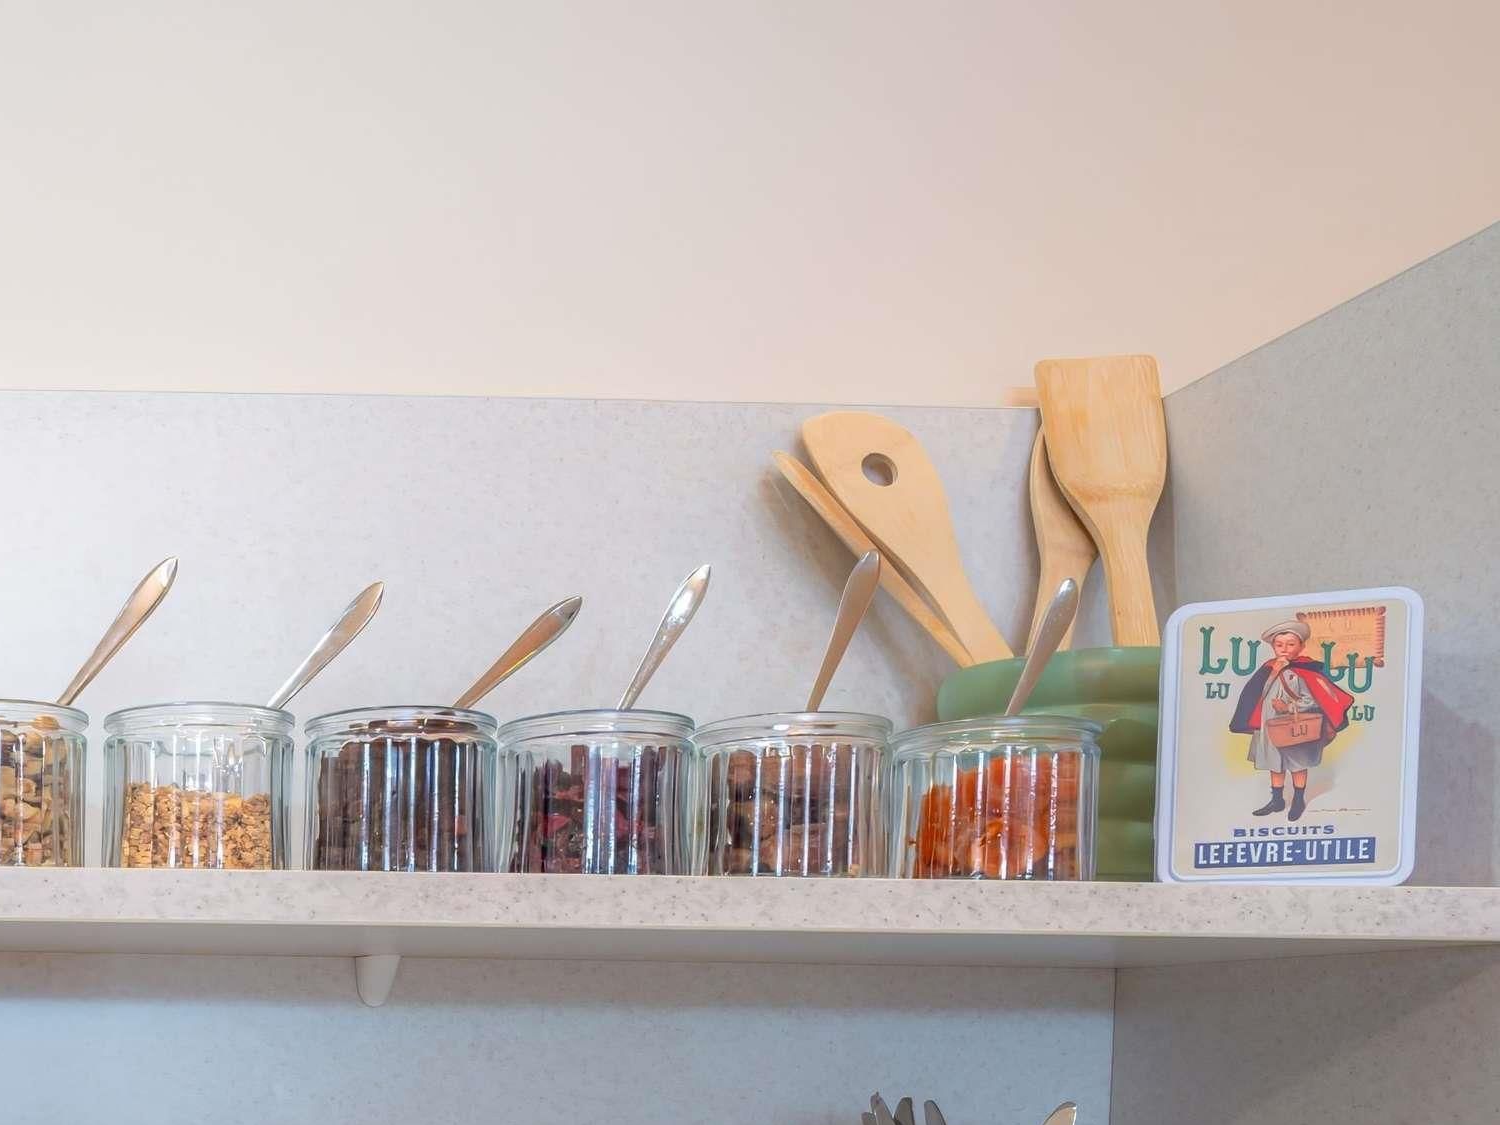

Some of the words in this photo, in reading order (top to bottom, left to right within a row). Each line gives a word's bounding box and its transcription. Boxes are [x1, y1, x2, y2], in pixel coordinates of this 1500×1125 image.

[1199, 626, 1260, 676] LU
[1320, 641, 1376, 693] LU
[1205, 682, 1231, 699] LU
[1351, 705, 1376, 721] LU
[1233, 825, 1334, 837] BISCUITS
